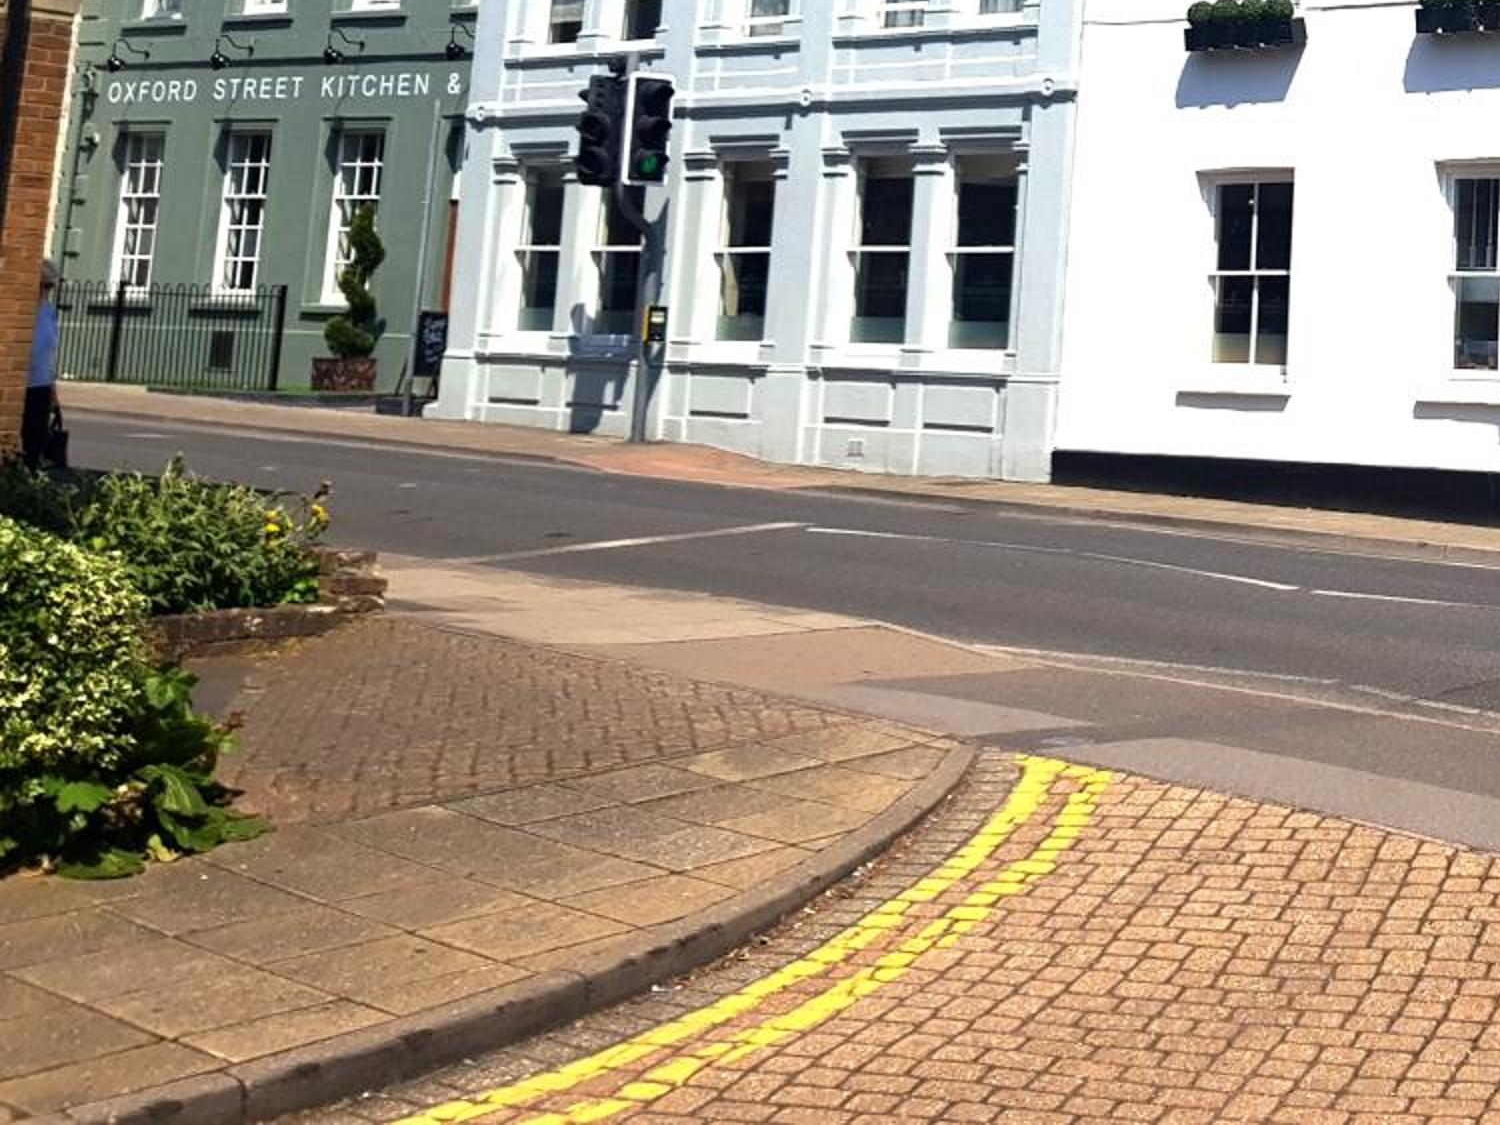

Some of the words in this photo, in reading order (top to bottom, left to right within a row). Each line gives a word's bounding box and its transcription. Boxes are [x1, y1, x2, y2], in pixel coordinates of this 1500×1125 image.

[108, 80, 198, 104] OXFORD
[213, 77, 303, 100] STREET
[321, 74, 430, 97] KITCHEN
[447, 72, 462, 94] &
